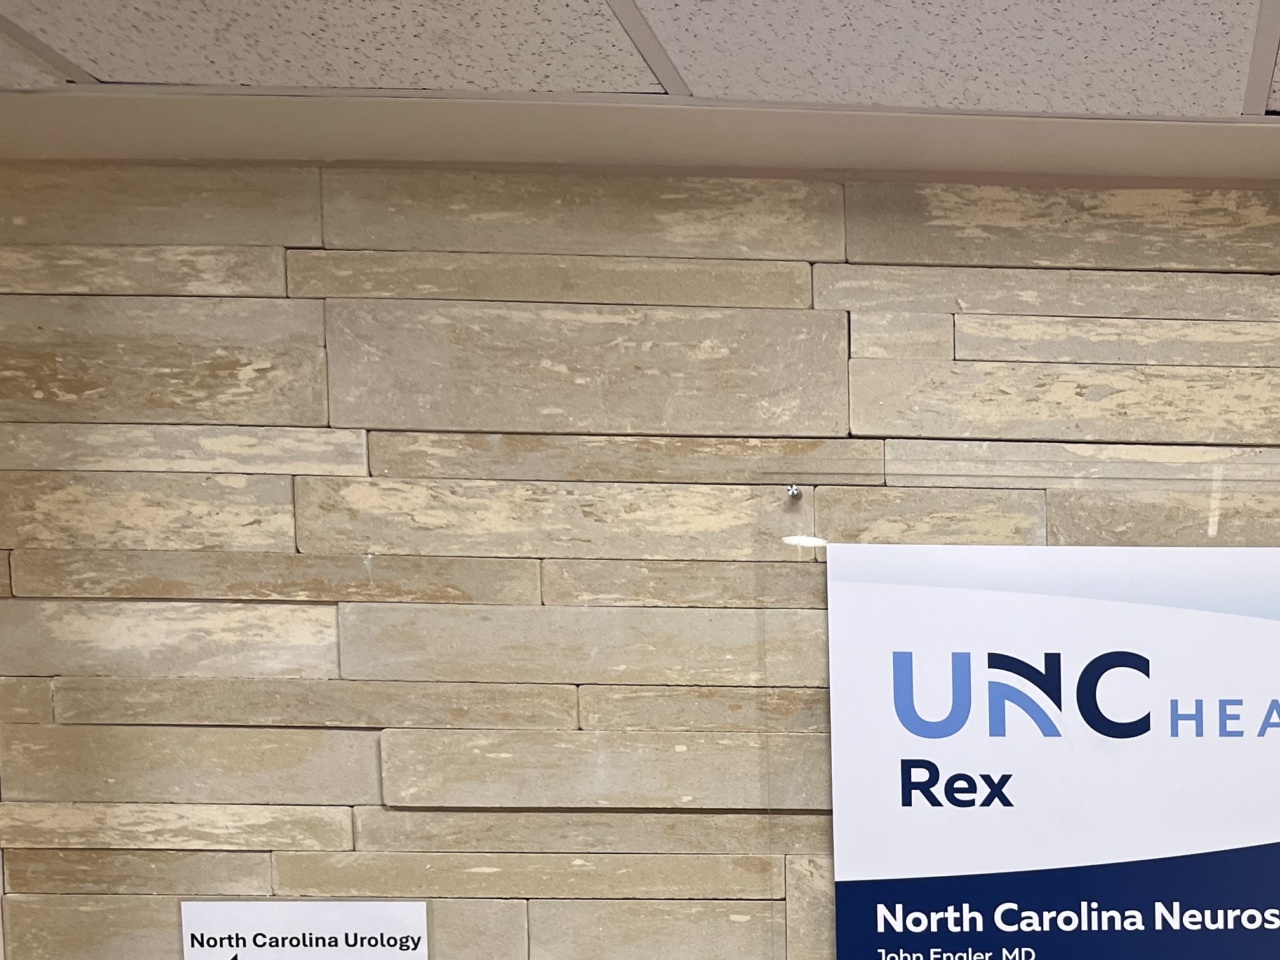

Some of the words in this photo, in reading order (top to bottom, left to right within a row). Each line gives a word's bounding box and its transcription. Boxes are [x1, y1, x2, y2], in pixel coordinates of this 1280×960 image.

[892, 650, 1152, 740] UNC
[900, 758, 1014, 808] Rex
[876, 903, 984, 933] North
[993, 901, 1145, 932] Carolina
[190, 932, 247, 948] North
[252, 932, 339, 948] Carolina
[344, 932, 422, 951] Urology
